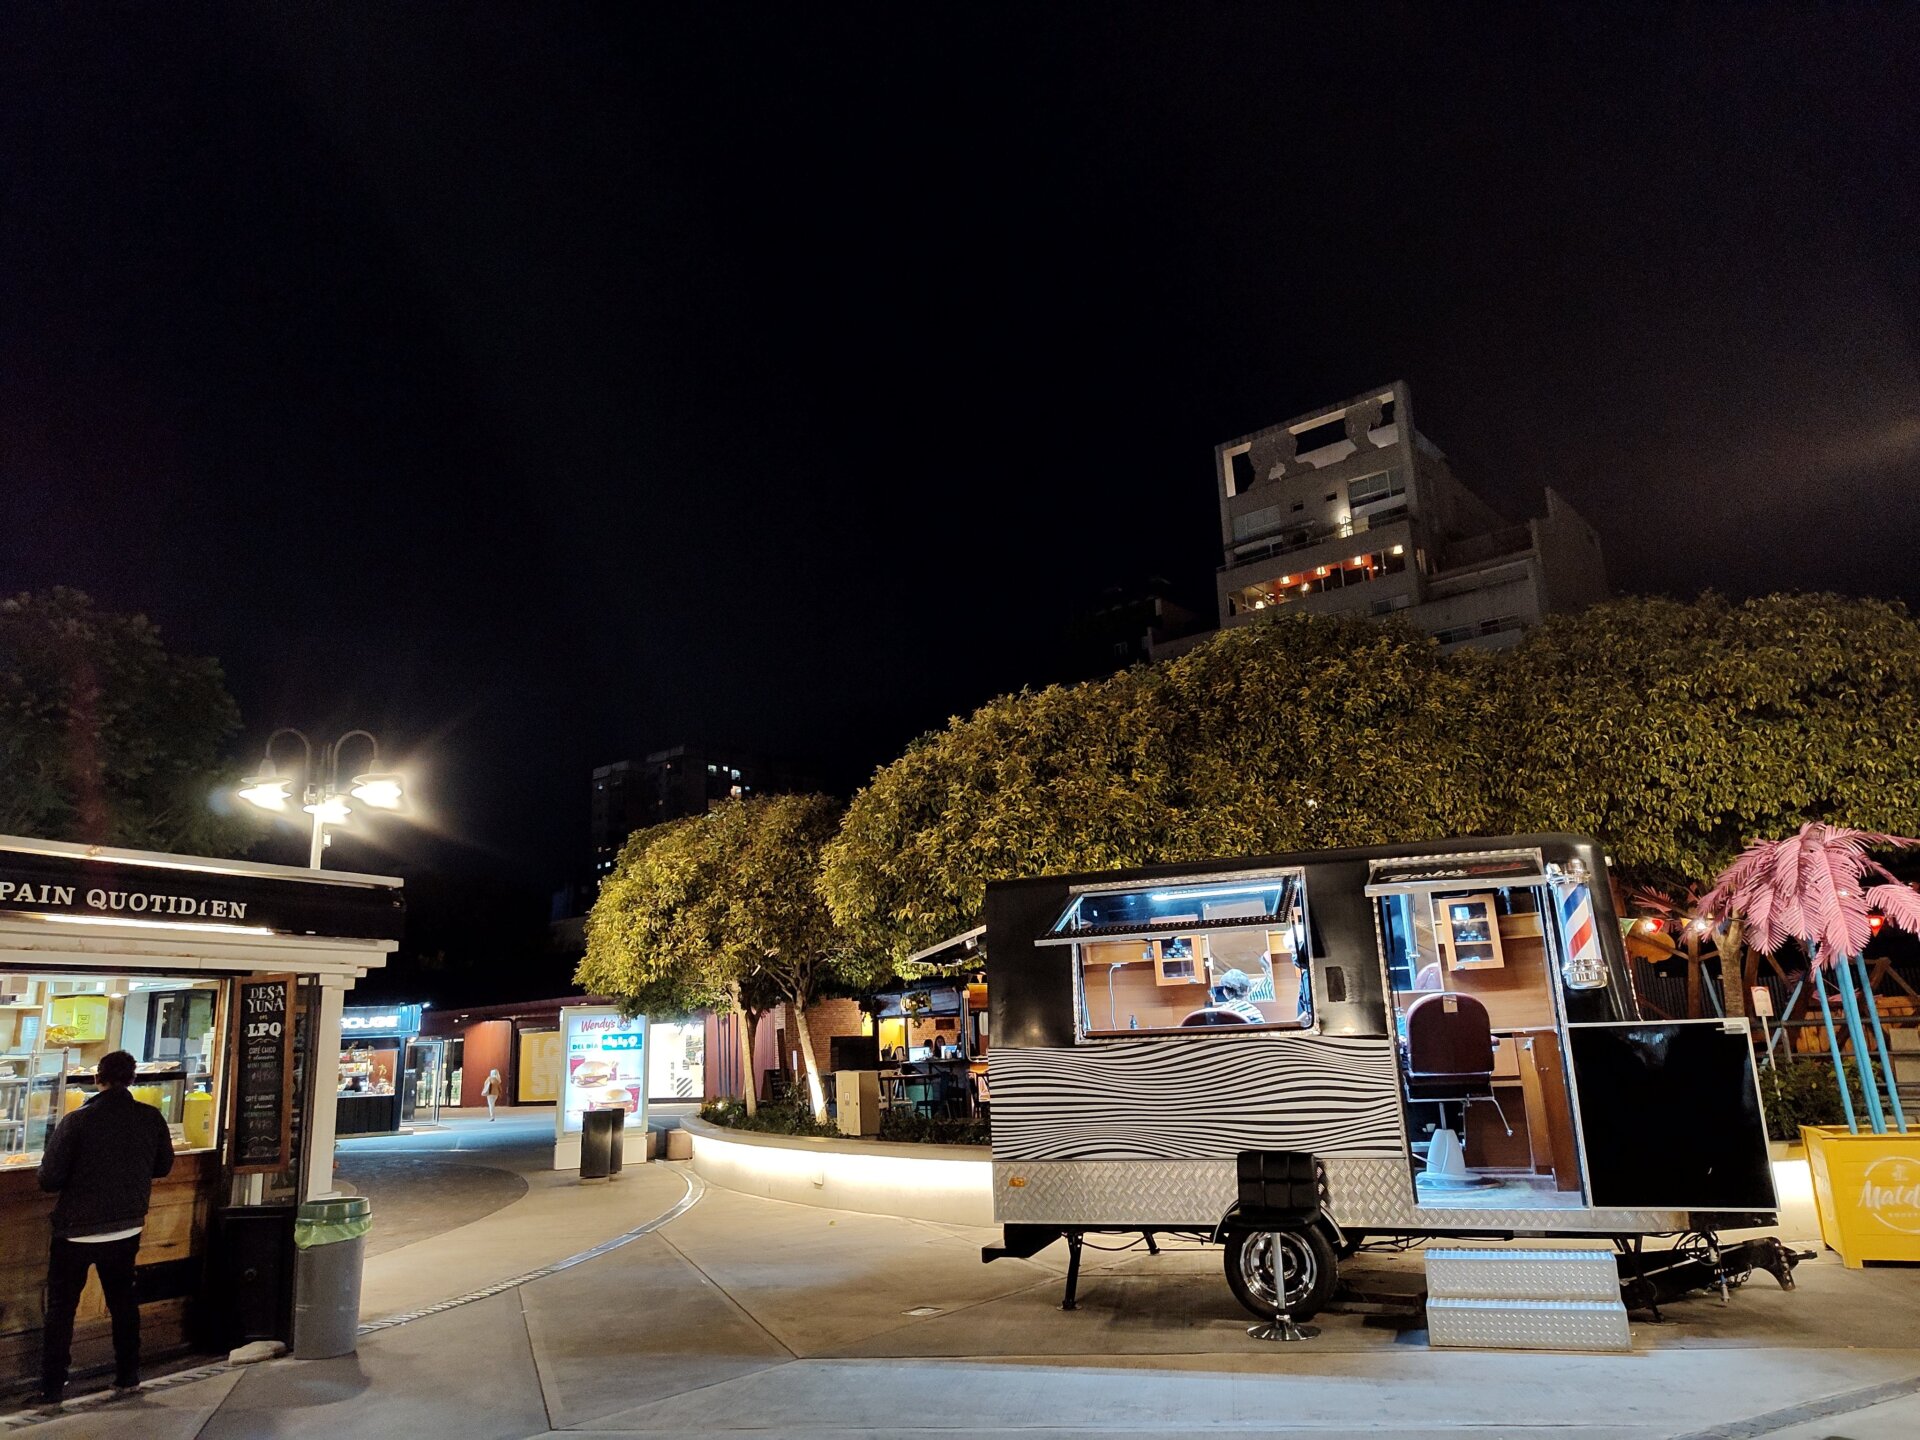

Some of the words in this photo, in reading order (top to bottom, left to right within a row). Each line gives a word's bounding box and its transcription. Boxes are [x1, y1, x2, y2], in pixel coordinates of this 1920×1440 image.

[0, 881, 76, 906] PAIN
[86, 889, 247, 919] QUOTIDIEN
[250, 985, 285, 1000] DESA
[247, 997, 285, 1014] YUNA
[248, 1022, 282, 1038] LPQ
[581, 1018, 616, 1033] Wendy's
